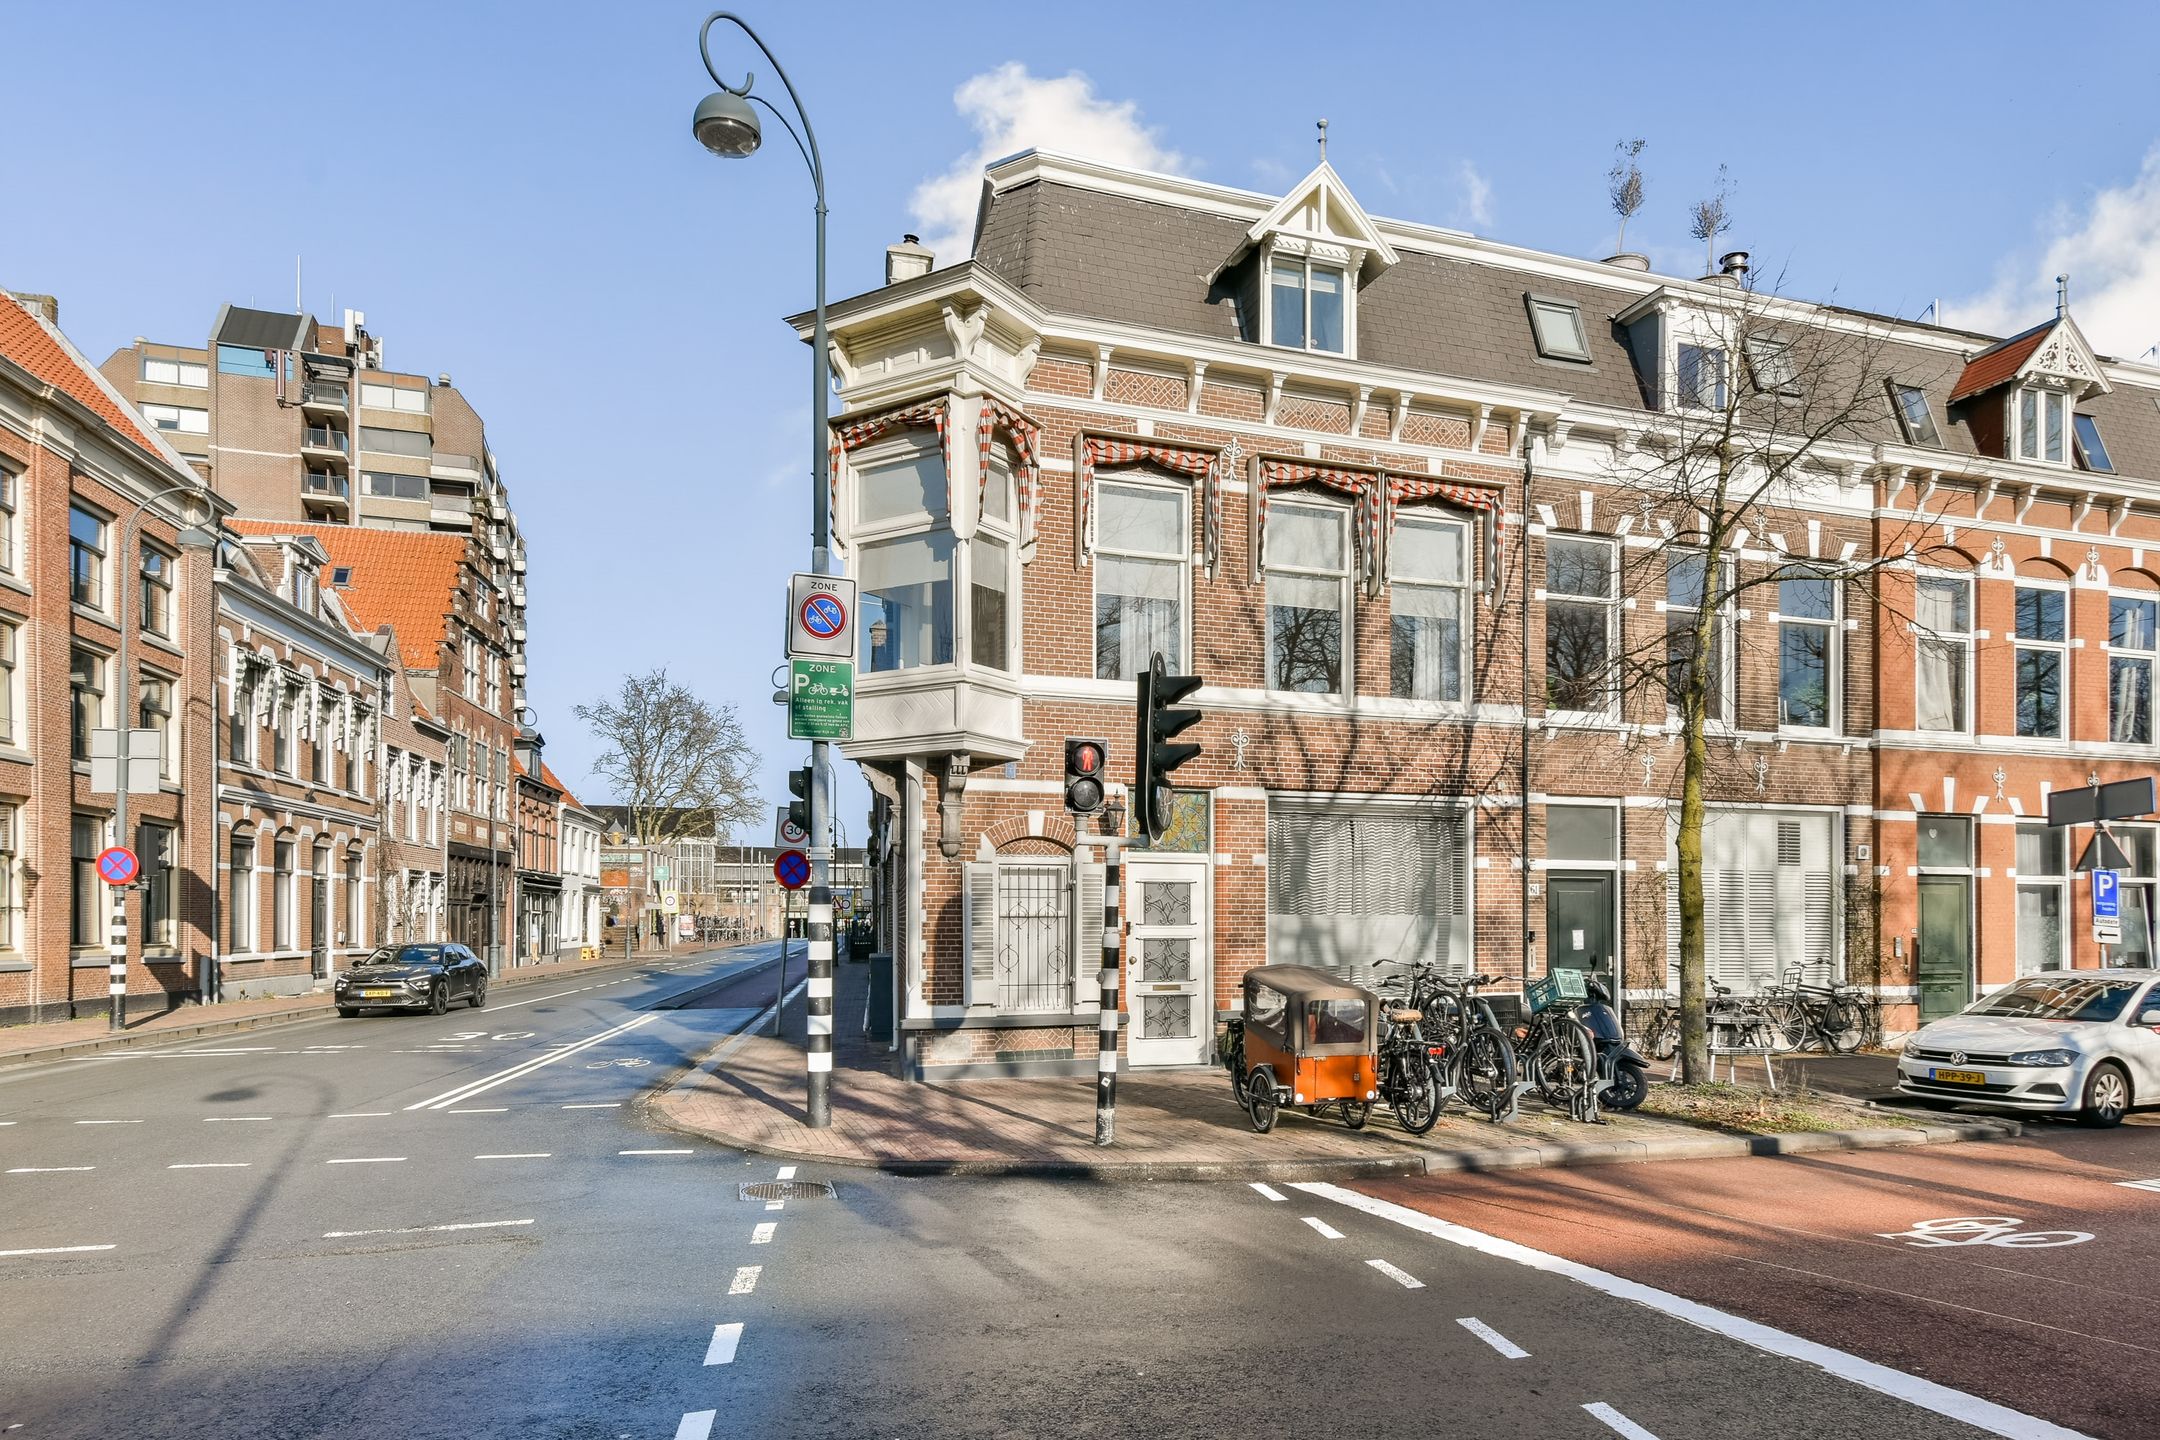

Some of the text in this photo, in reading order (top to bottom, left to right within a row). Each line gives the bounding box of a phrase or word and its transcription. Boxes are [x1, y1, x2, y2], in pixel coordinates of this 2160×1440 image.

[811, 581, 838, 592] ZONE
[809, 664, 836, 673] ZONE
[795, 673, 810, 694] P
[785, 825, 803, 836] 30
[2099, 874, 2113, 896] P
[437, 1031, 536, 1041] 30
[1938, 1071, 1981, 1083] HPP-39-J
